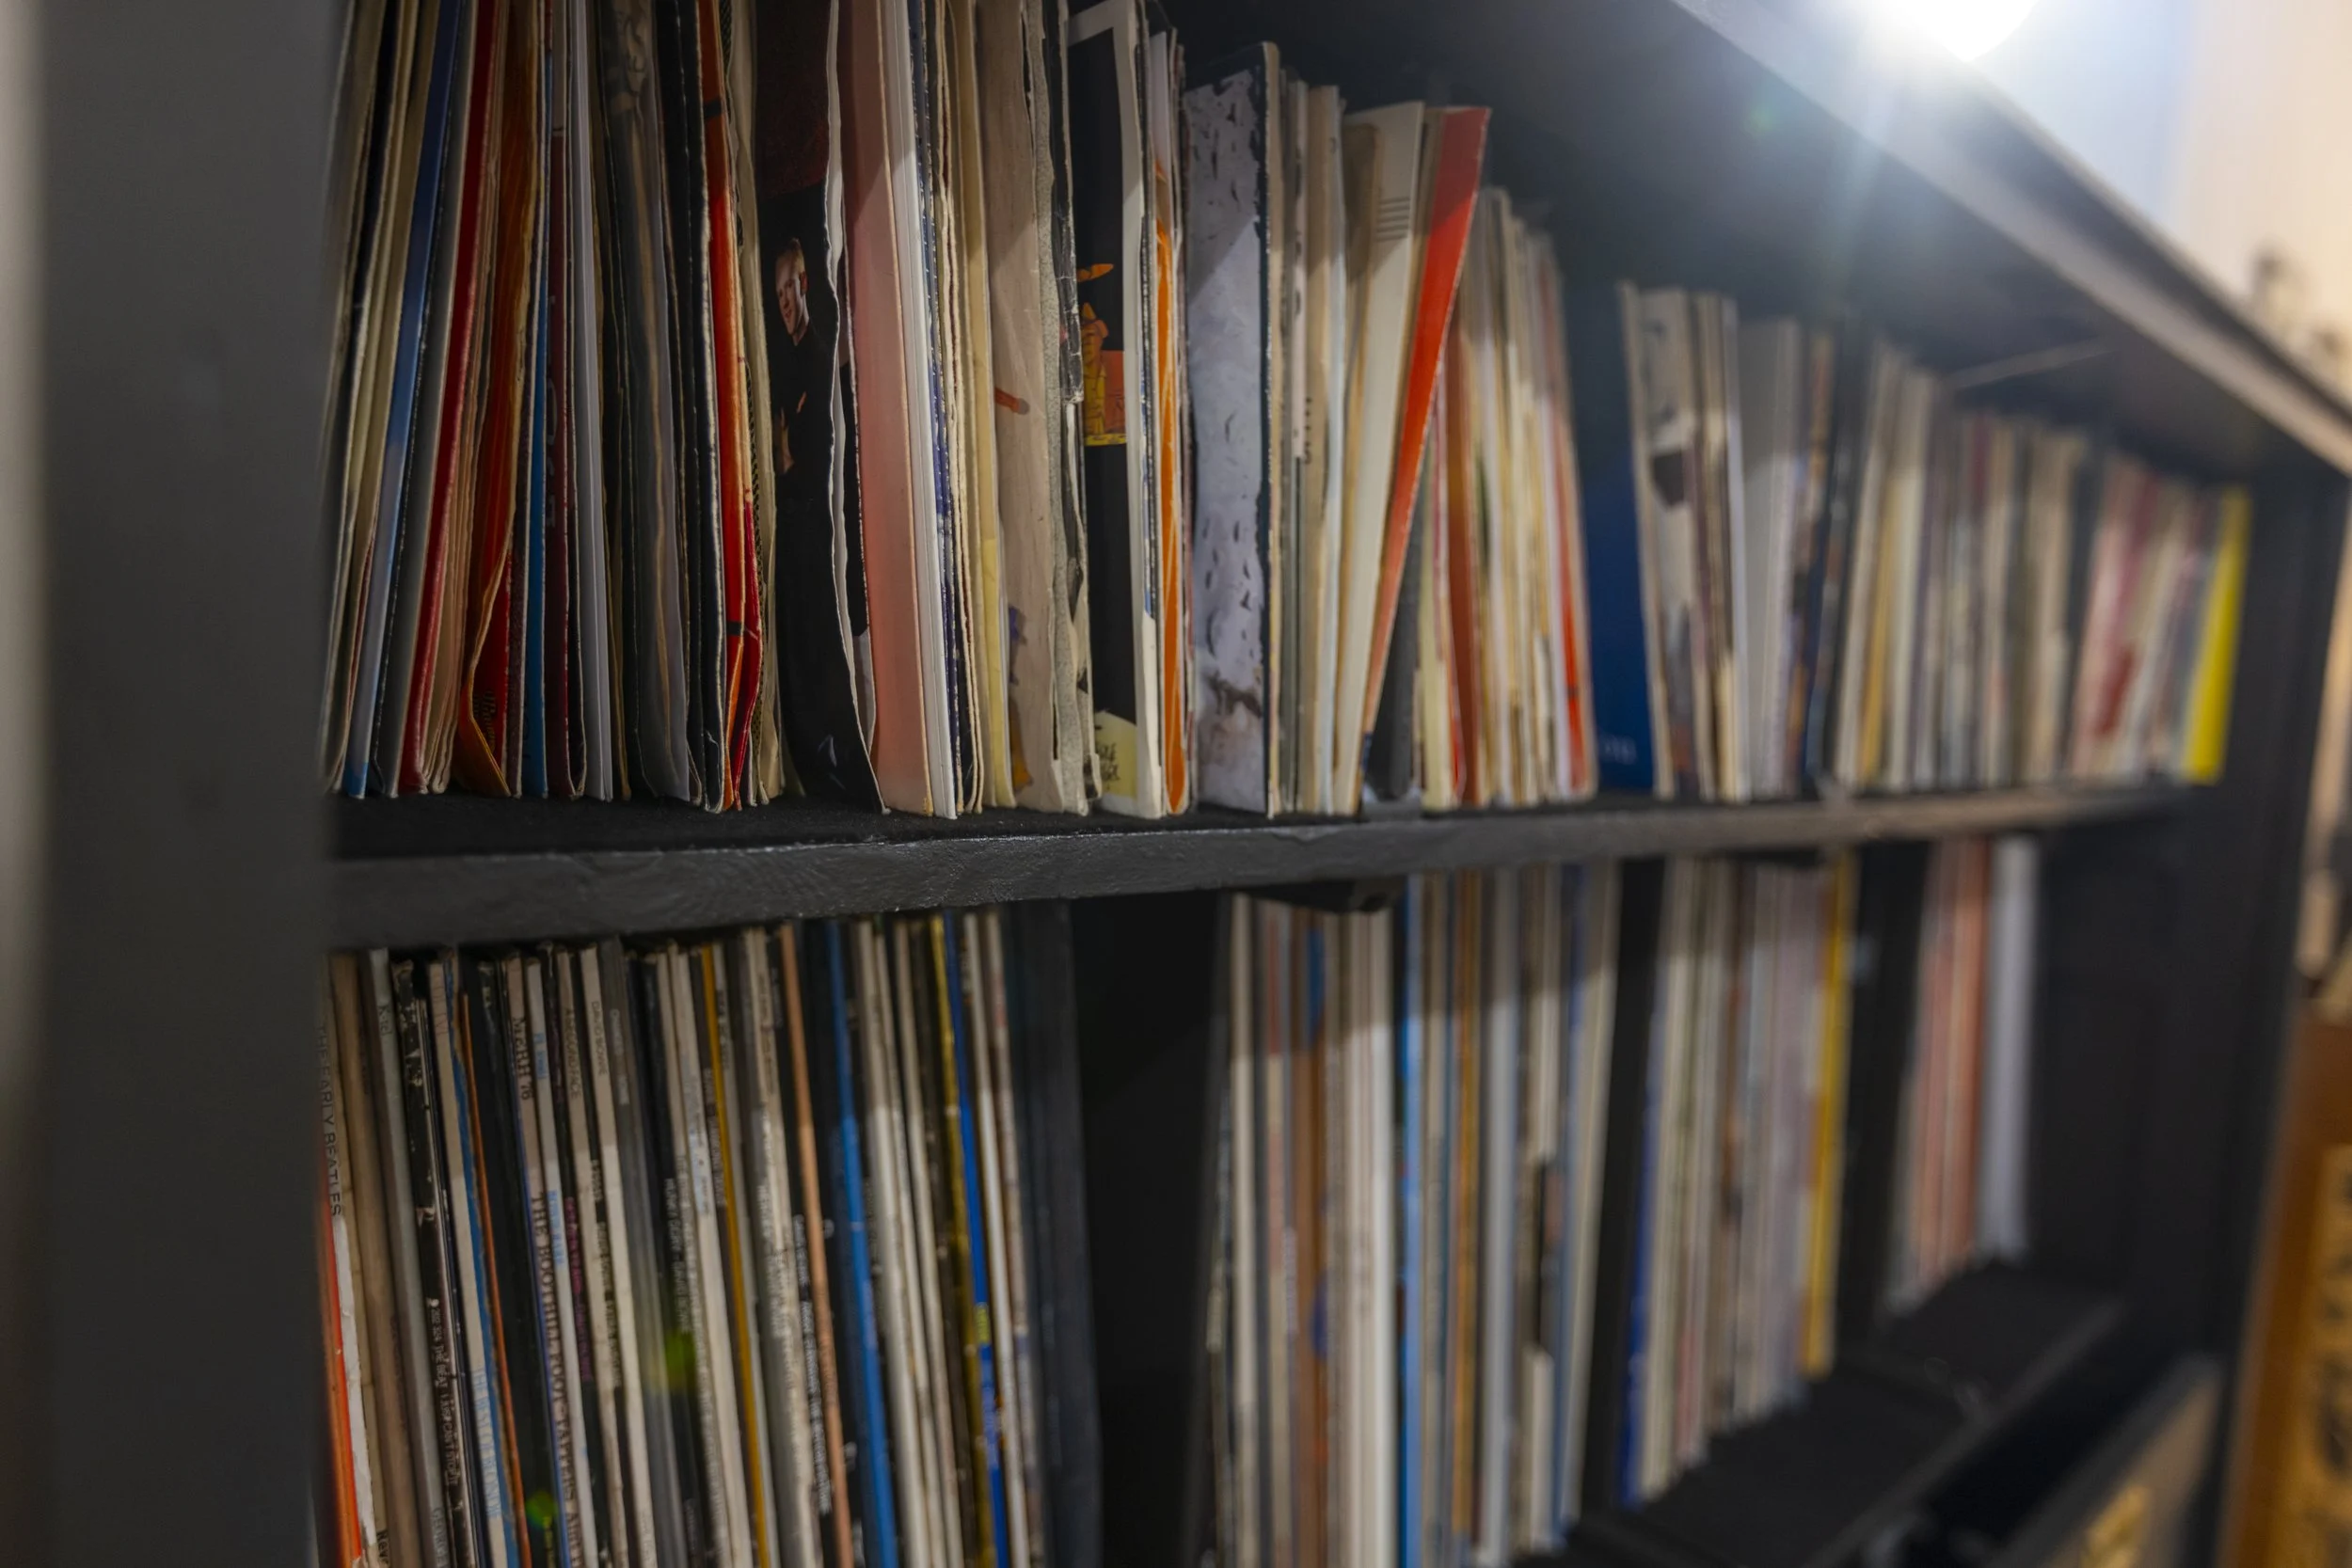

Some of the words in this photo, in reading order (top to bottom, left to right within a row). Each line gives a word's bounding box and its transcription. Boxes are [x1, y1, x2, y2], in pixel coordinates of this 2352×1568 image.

[315, 1025, 327, 1059] THE
[319, 1066, 335, 1125] EARLY
[324, 1133, 342, 1216] BEATLES
[532, 1192, 548, 1235] THE
